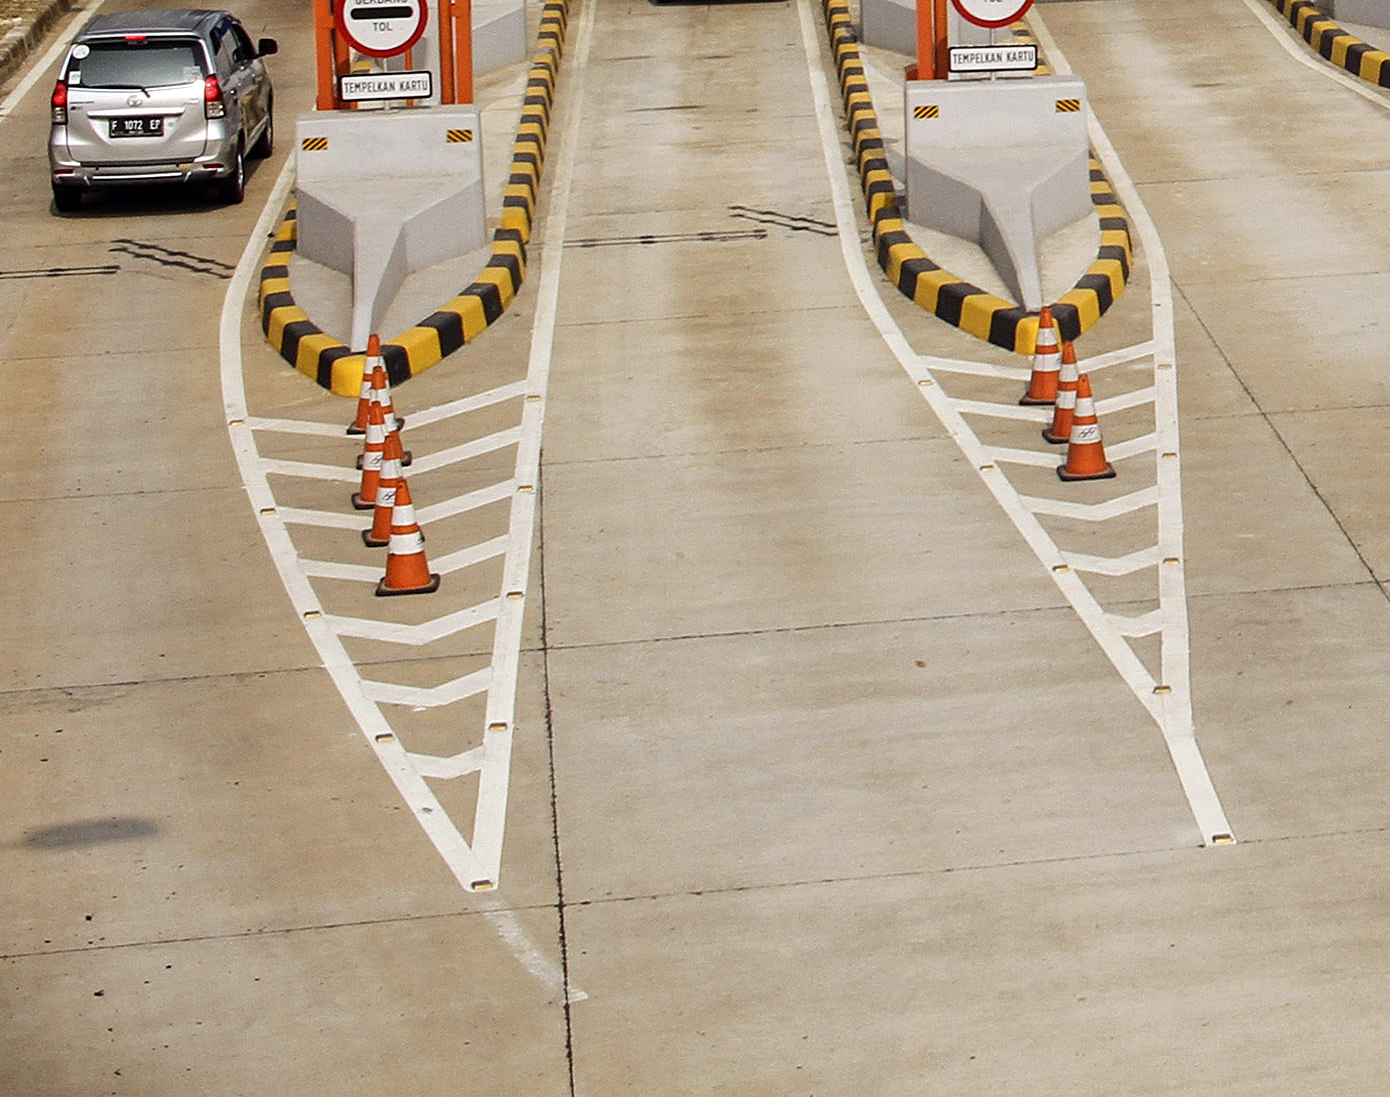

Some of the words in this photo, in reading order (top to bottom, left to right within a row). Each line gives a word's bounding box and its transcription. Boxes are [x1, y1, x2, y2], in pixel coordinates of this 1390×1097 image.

[373, 22, 393, 31] TOL
[953, 52, 1003, 64] TEMPELKAN
[1006, 50, 1034, 62] KARTU
[344, 82, 395, 94] TEMPELKAN
[399, 80, 428, 91] KARTU
[112, 120, 118, 131] F
[124, 119, 143, 131] 1072
